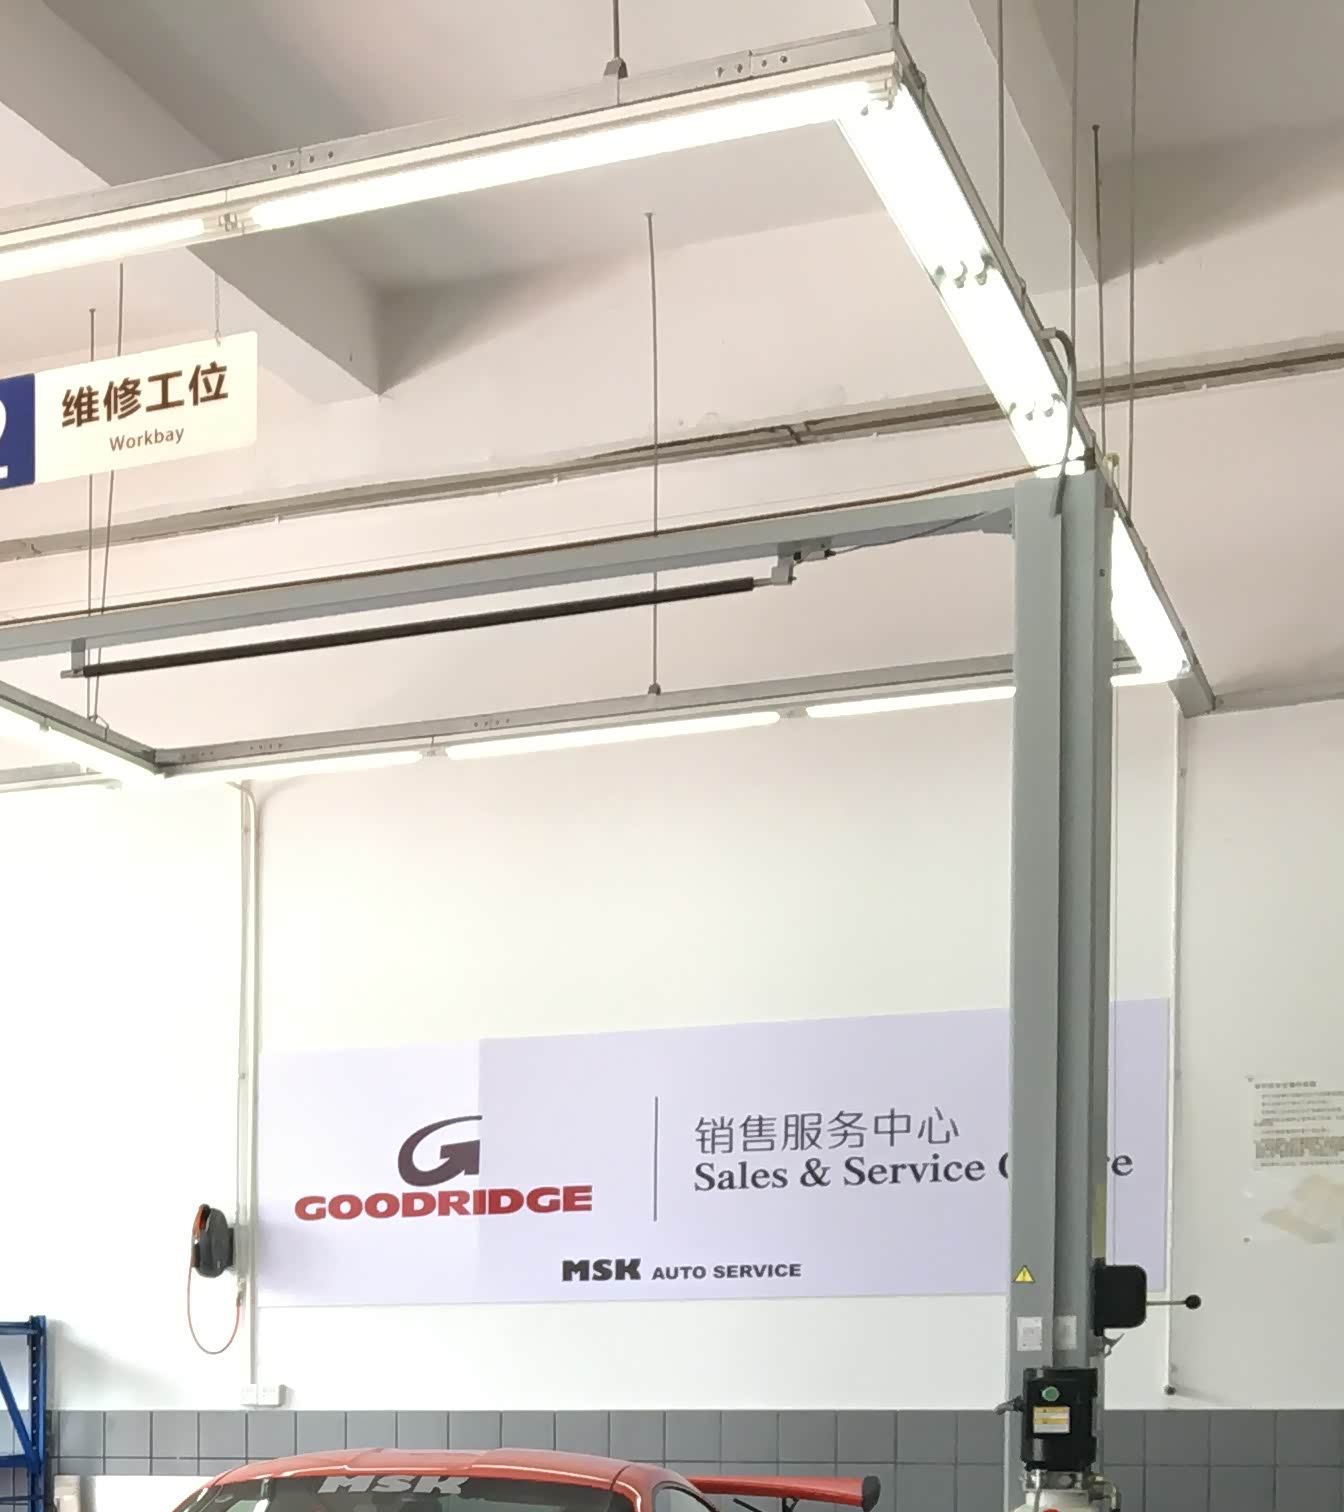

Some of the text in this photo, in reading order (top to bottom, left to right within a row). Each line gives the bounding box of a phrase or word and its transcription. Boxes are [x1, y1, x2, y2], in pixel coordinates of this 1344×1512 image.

[61, 361, 229, 428] 维修工位
[109, 427, 185, 452] Workbay
[695, 1106, 960, 1155] 销售服务中心
[694, 1160, 789, 1192] Sales
[799, 1157, 832, 1188] &
[843, 1152, 986, 1187] Service
[294, 1184, 593, 1222] GOODRIDGE
[562, 1258, 803, 1282] MSK AUTO SERVICE
[317, 1474, 471, 1496] MSK
